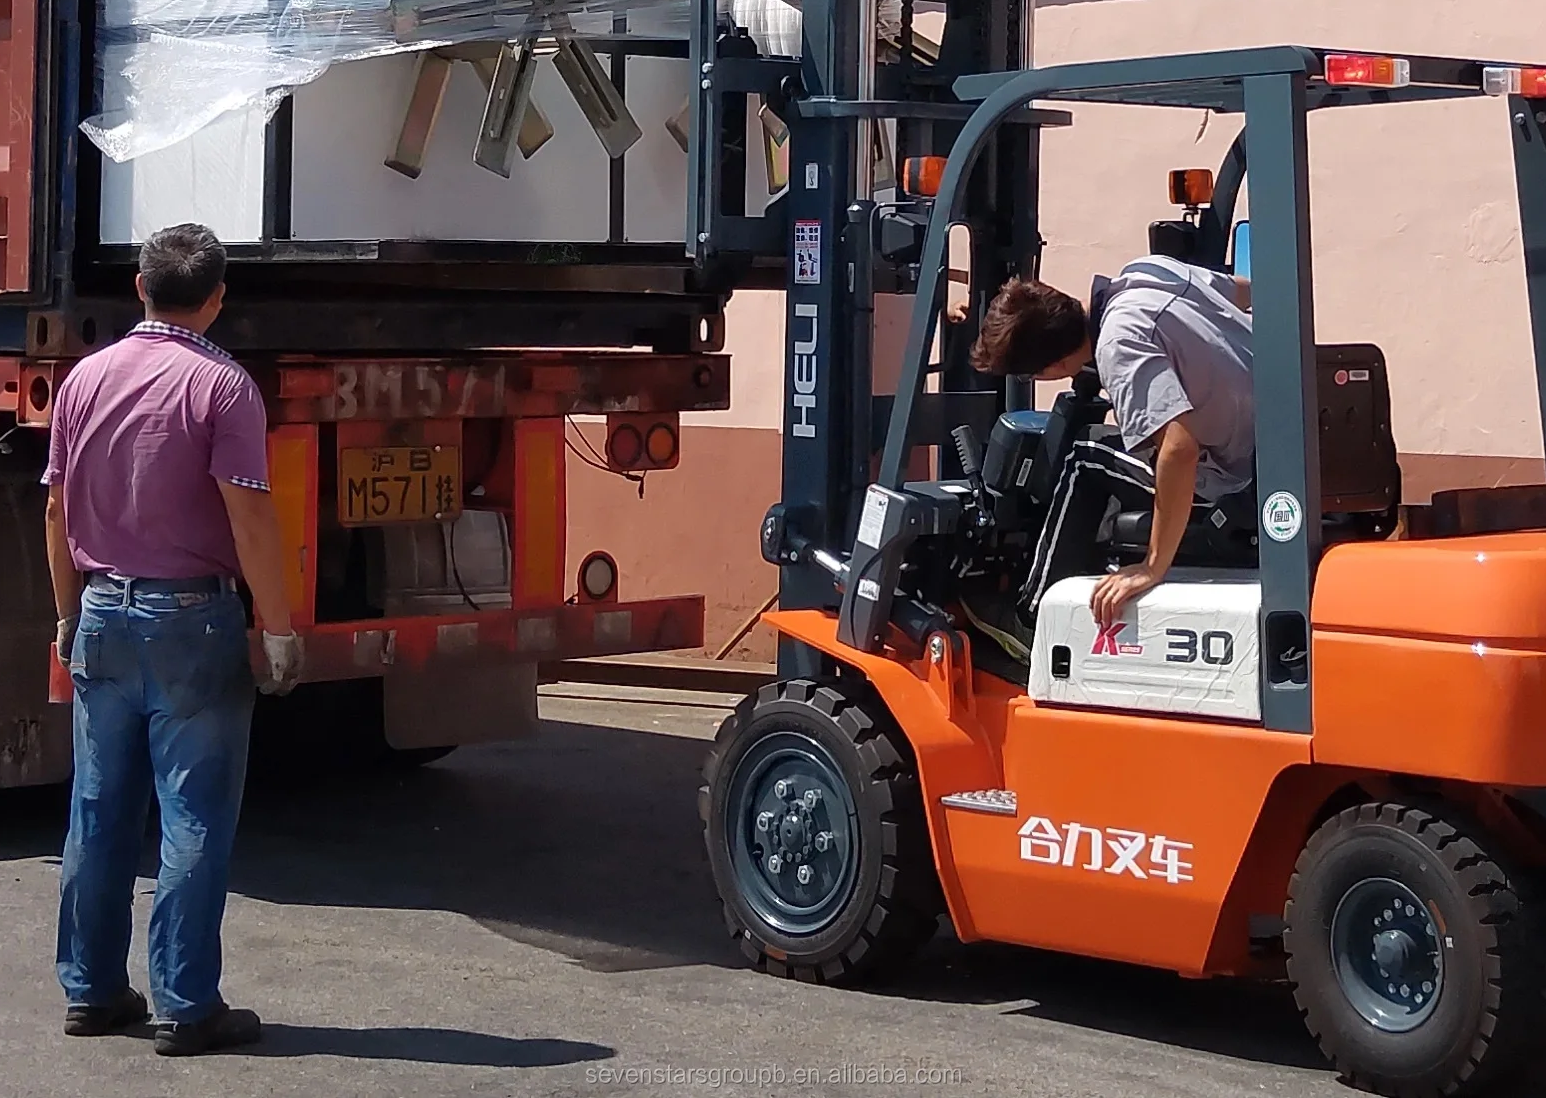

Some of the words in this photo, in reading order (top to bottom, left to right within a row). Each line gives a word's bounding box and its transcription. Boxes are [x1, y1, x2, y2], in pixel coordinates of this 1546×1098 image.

[793, 304, 818, 438] HELI
[1165, 627, 1234, 666] 30
[1017, 815, 1195, 884] 合力叉车
